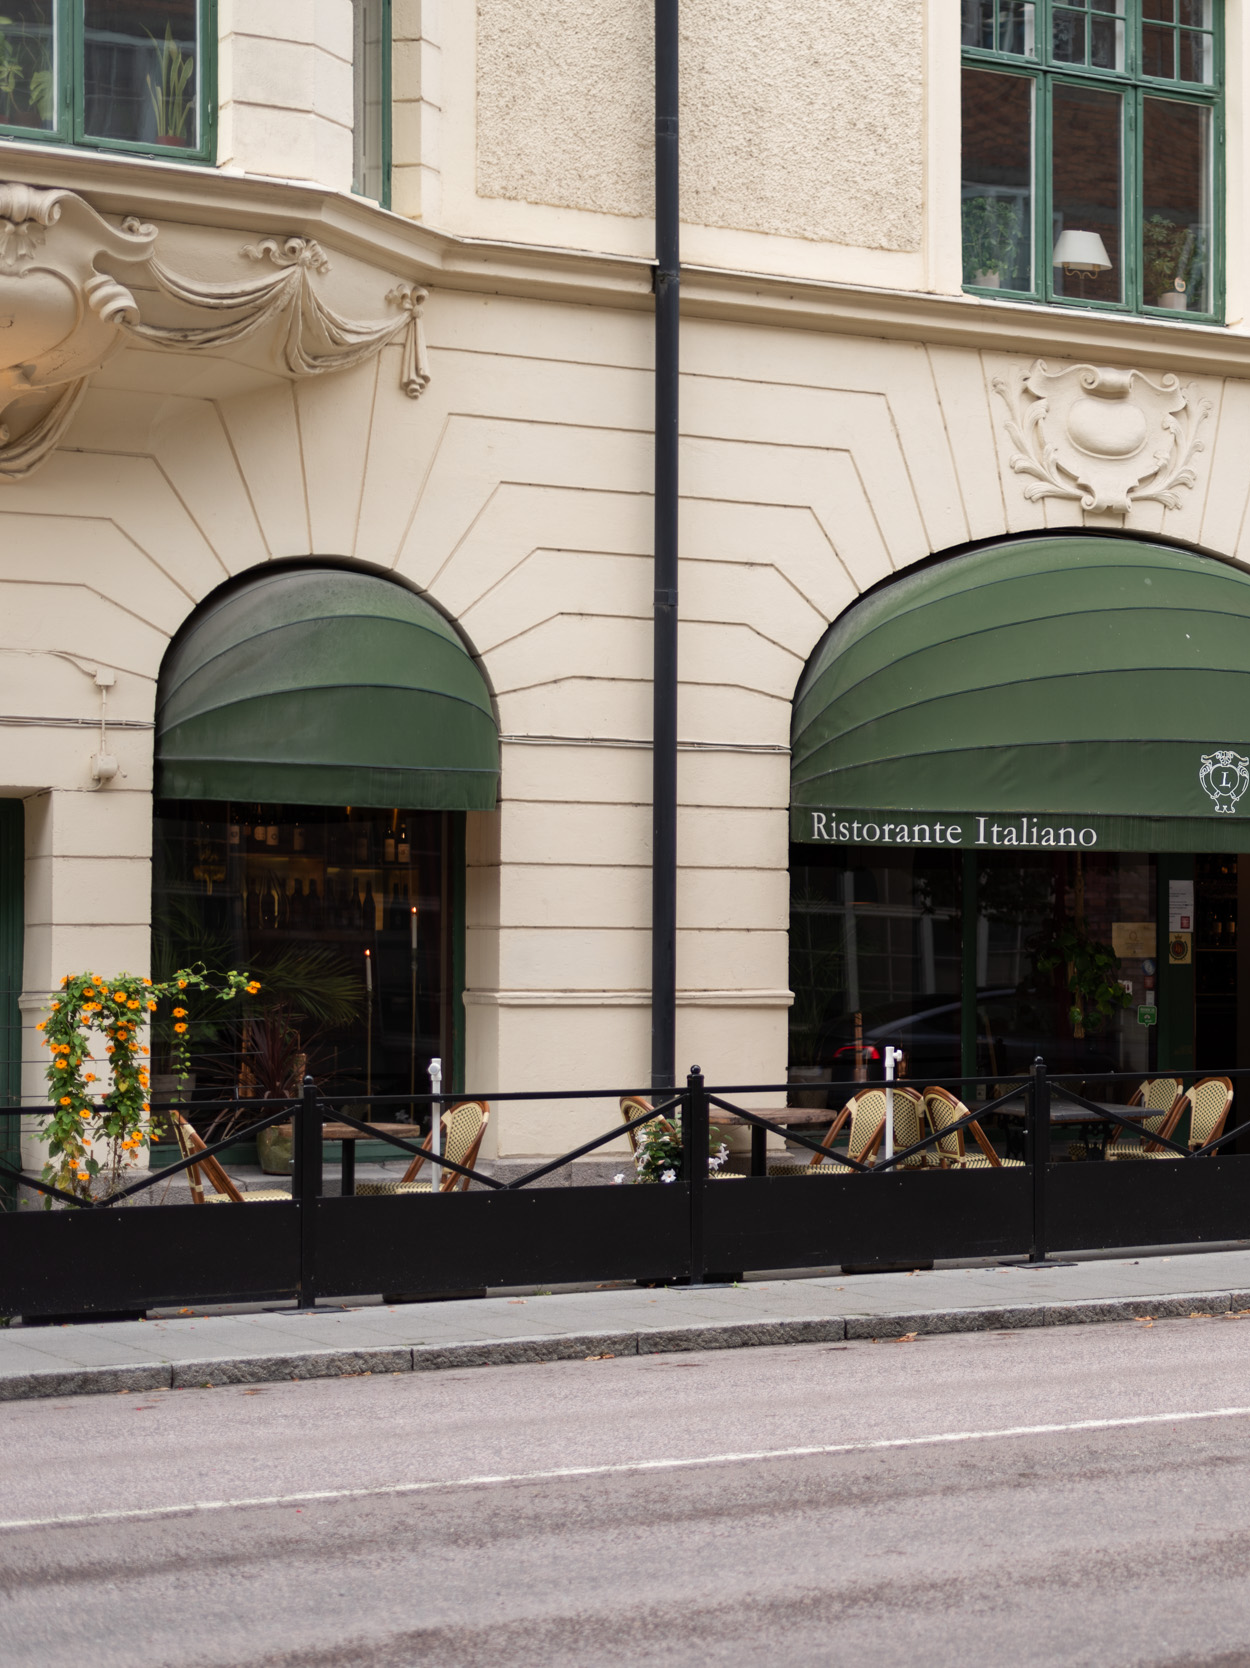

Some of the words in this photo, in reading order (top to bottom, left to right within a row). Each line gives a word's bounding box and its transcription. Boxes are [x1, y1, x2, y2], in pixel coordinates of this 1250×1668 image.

[1219, 771, 1232, 788] L
[811, 811, 963, 844] Ristorante
[974, 816, 1098, 847] Italiano
